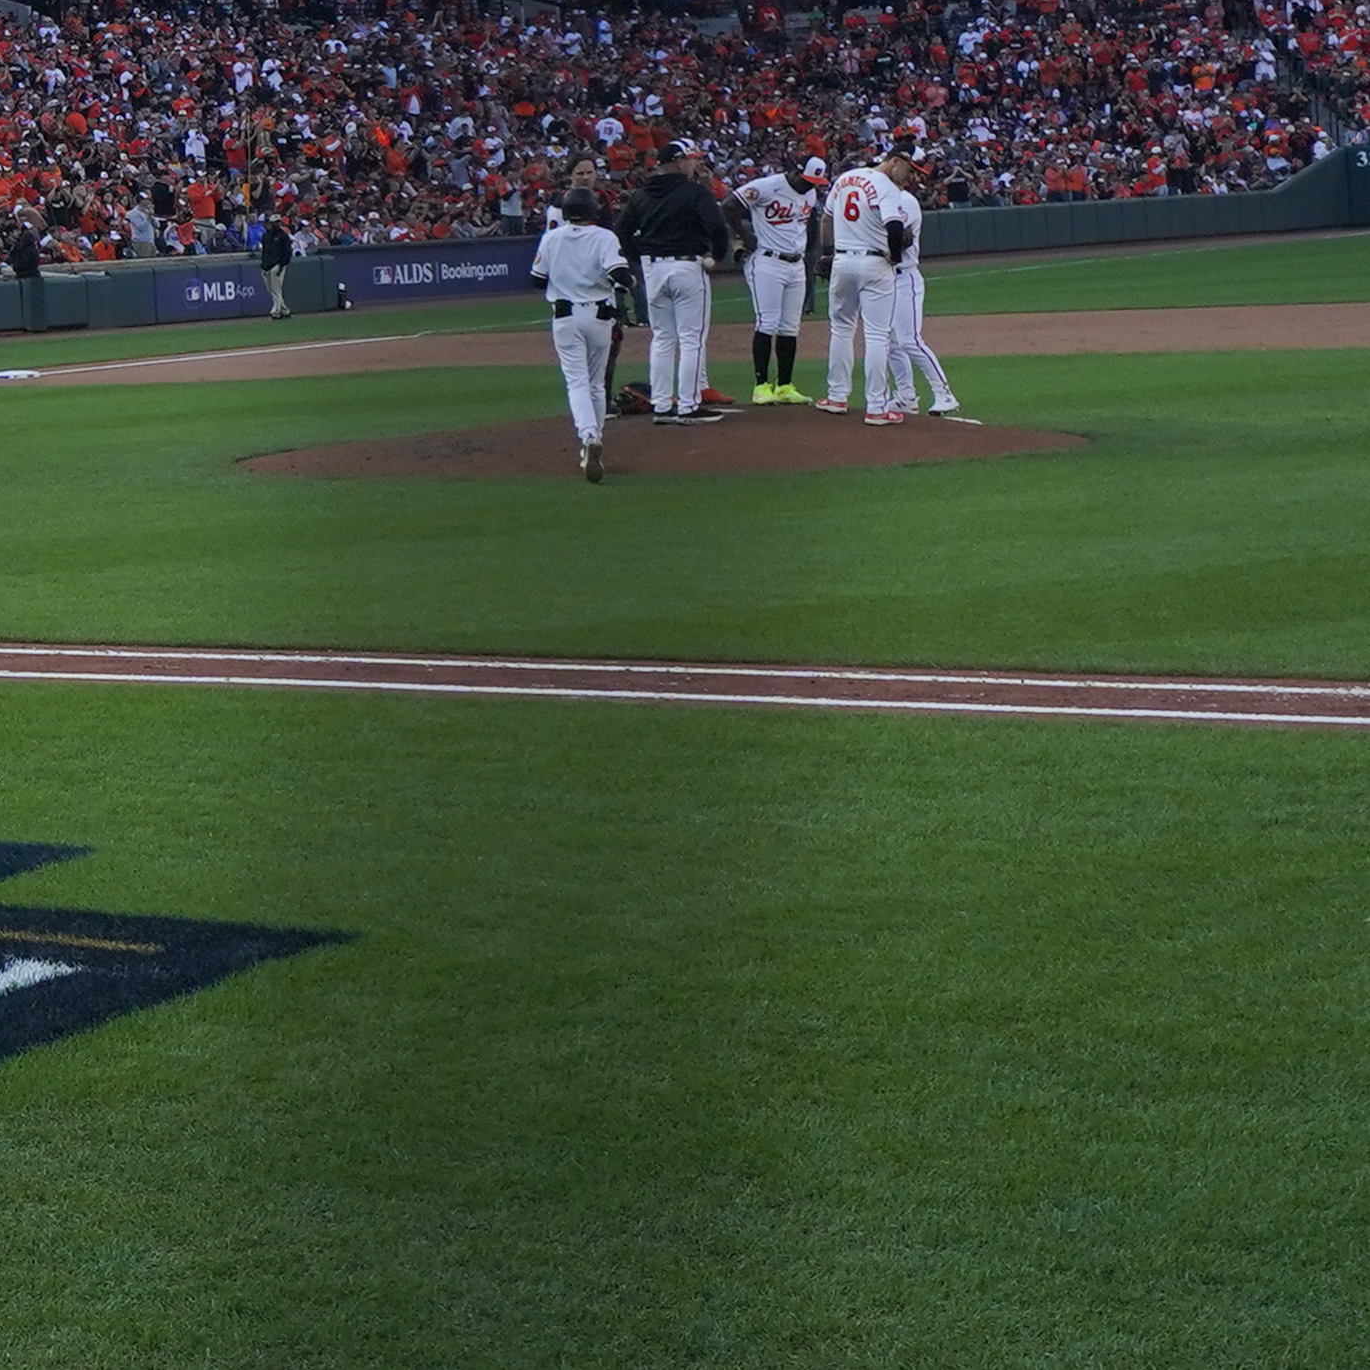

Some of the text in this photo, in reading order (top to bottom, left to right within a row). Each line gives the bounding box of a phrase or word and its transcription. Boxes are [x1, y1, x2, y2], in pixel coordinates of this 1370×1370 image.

[1356, 151, 1370, 168] 3
[843, 190, 861, 222] 6
[393, 260, 509, 285] ALDS Booking.com
[203, 280, 236, 302] MLB
